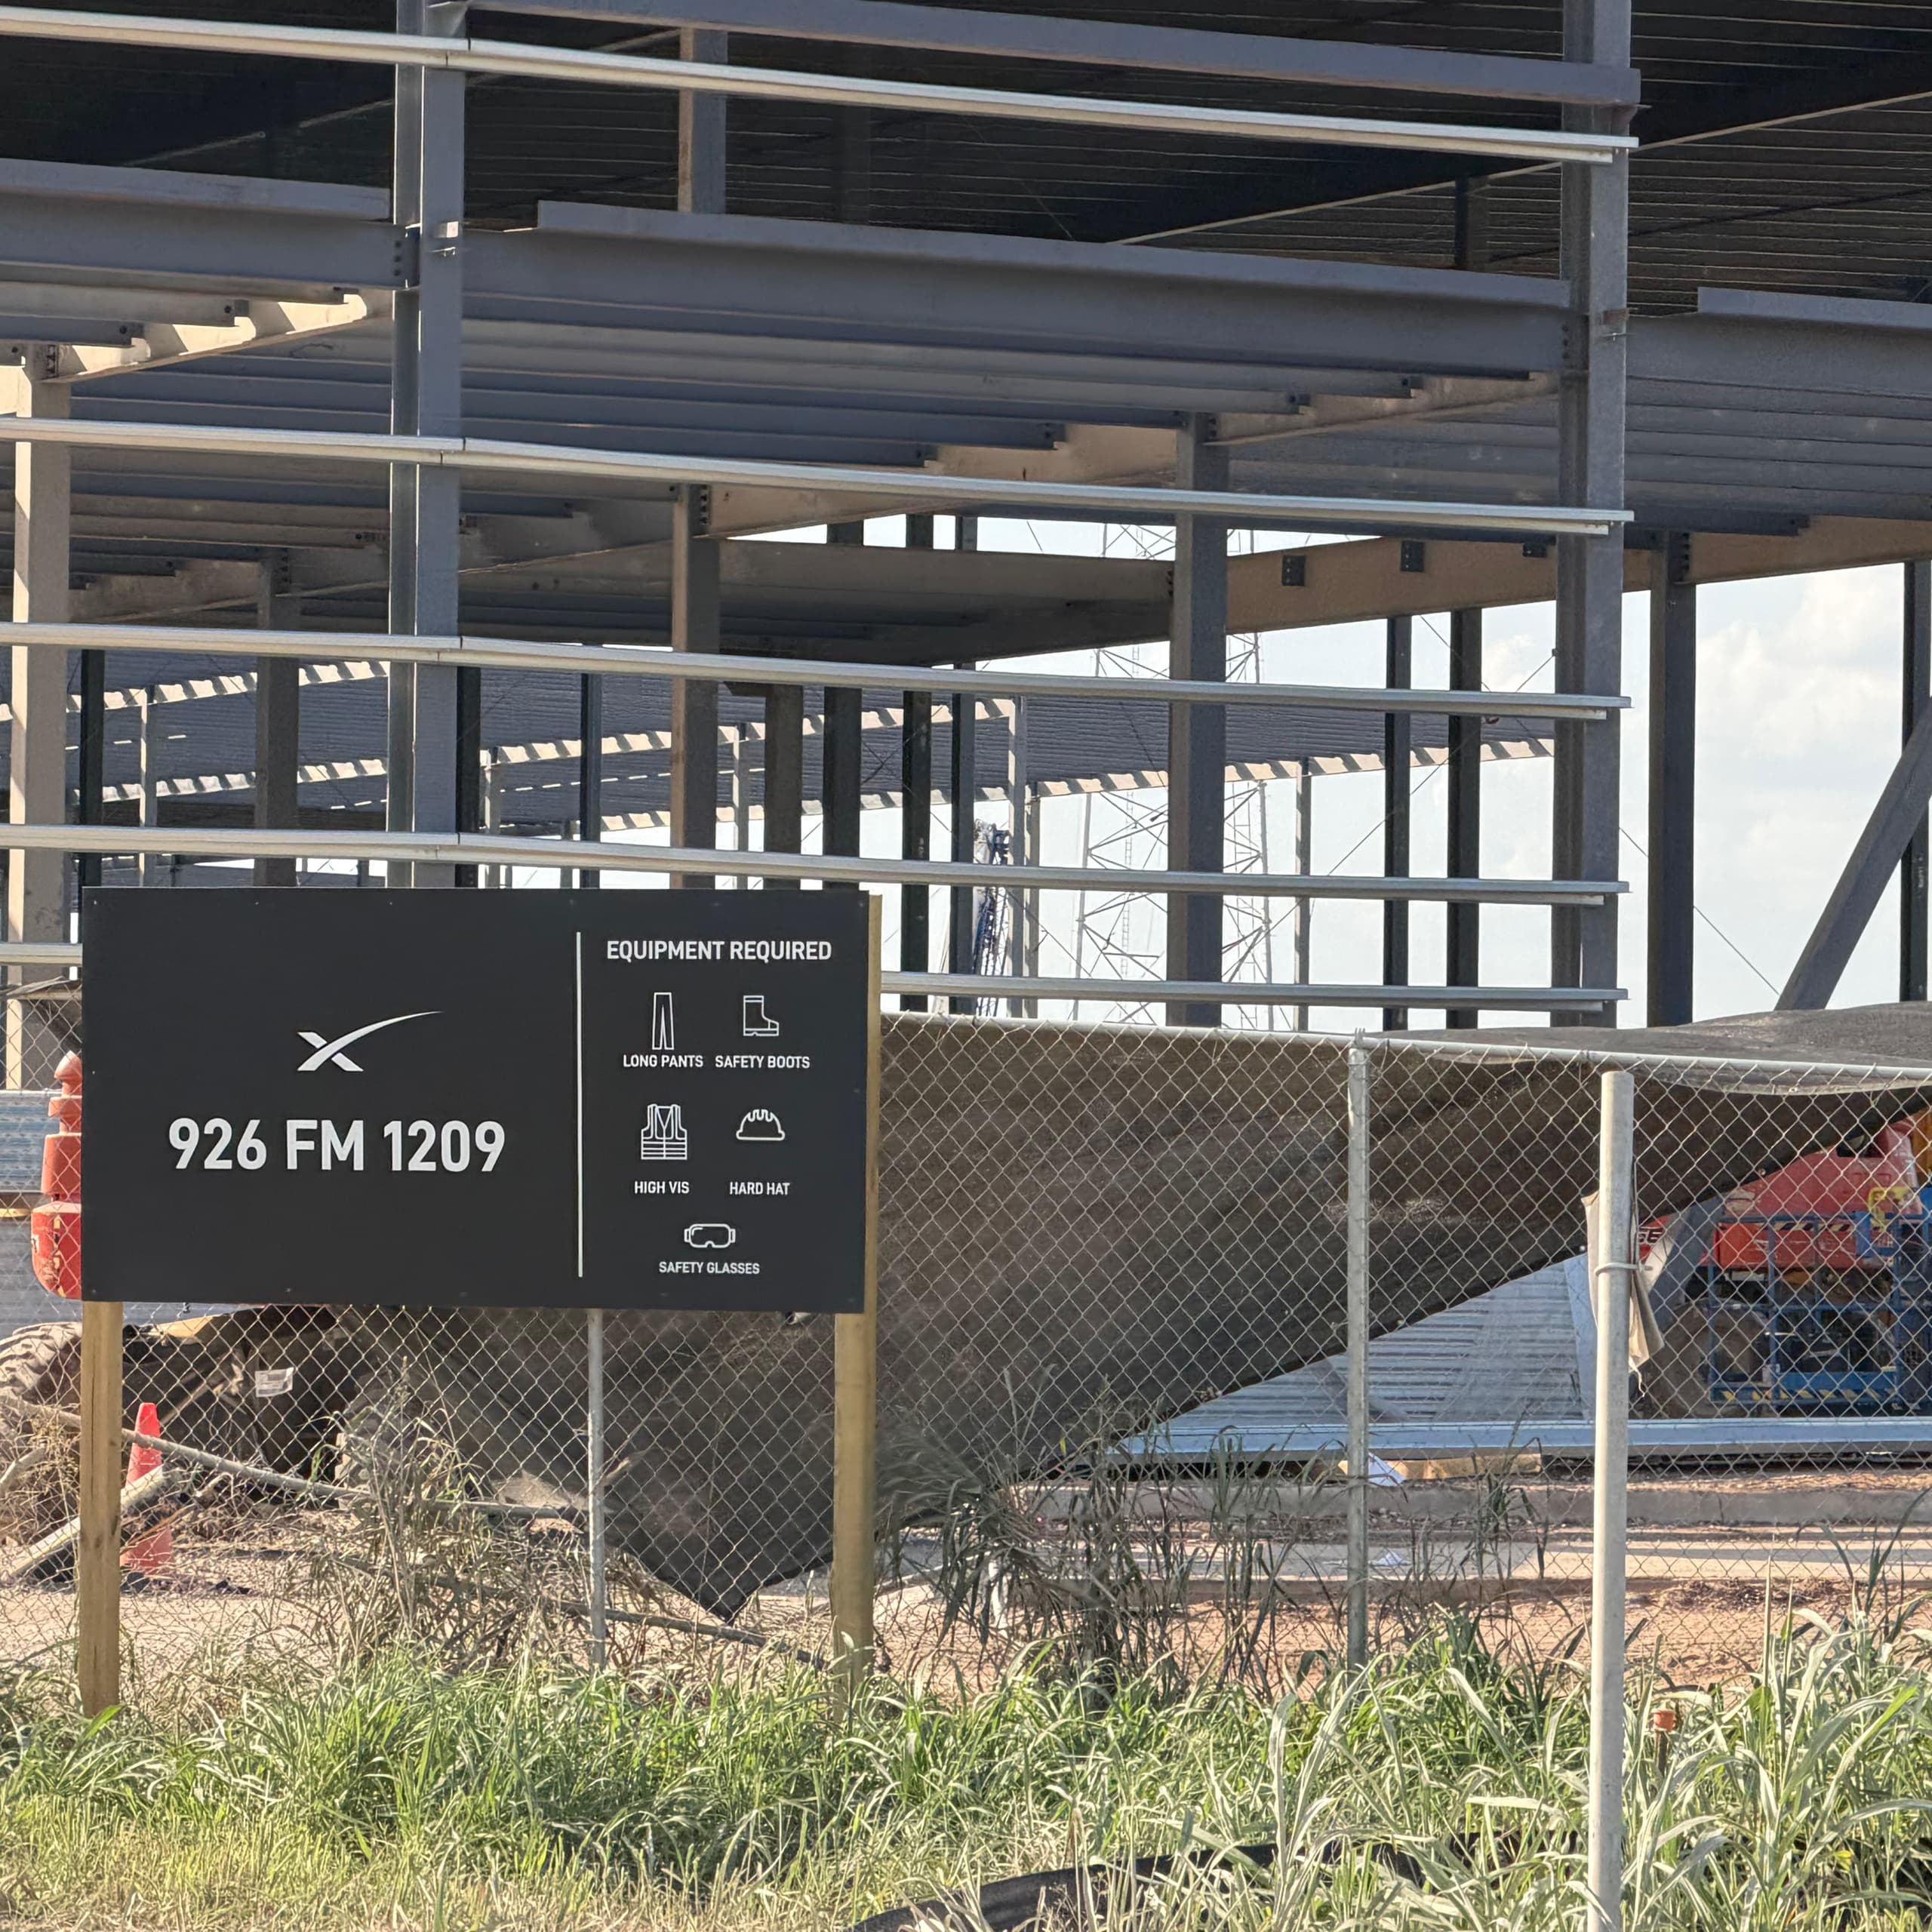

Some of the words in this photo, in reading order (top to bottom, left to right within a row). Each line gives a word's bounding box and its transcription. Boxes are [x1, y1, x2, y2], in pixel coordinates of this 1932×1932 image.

[607, 940, 725, 963] EQUIPMENT
[730, 940, 832, 963] REQUIRED
[623, 1054, 657, 1068] LONG
[661, 1054, 704, 1068] PANTS
[715, 1055, 764, 1069] SAFETY
[768, 1056, 811, 1069] BOOTS
[168, 1118, 266, 1170] 926
[287, 1120, 364, 1171] FM
[384, 1120, 505, 1172] 1209
[634, 1181, 665, 1194] HIGH
[669, 1181, 690, 1194] VIS
[730, 1182, 764, 1195] HARD
[767, 1183, 791, 1195] HAT
[659, 1261, 703, 1274] SAFETY
[707, 1262, 760, 1275] GLASSES
